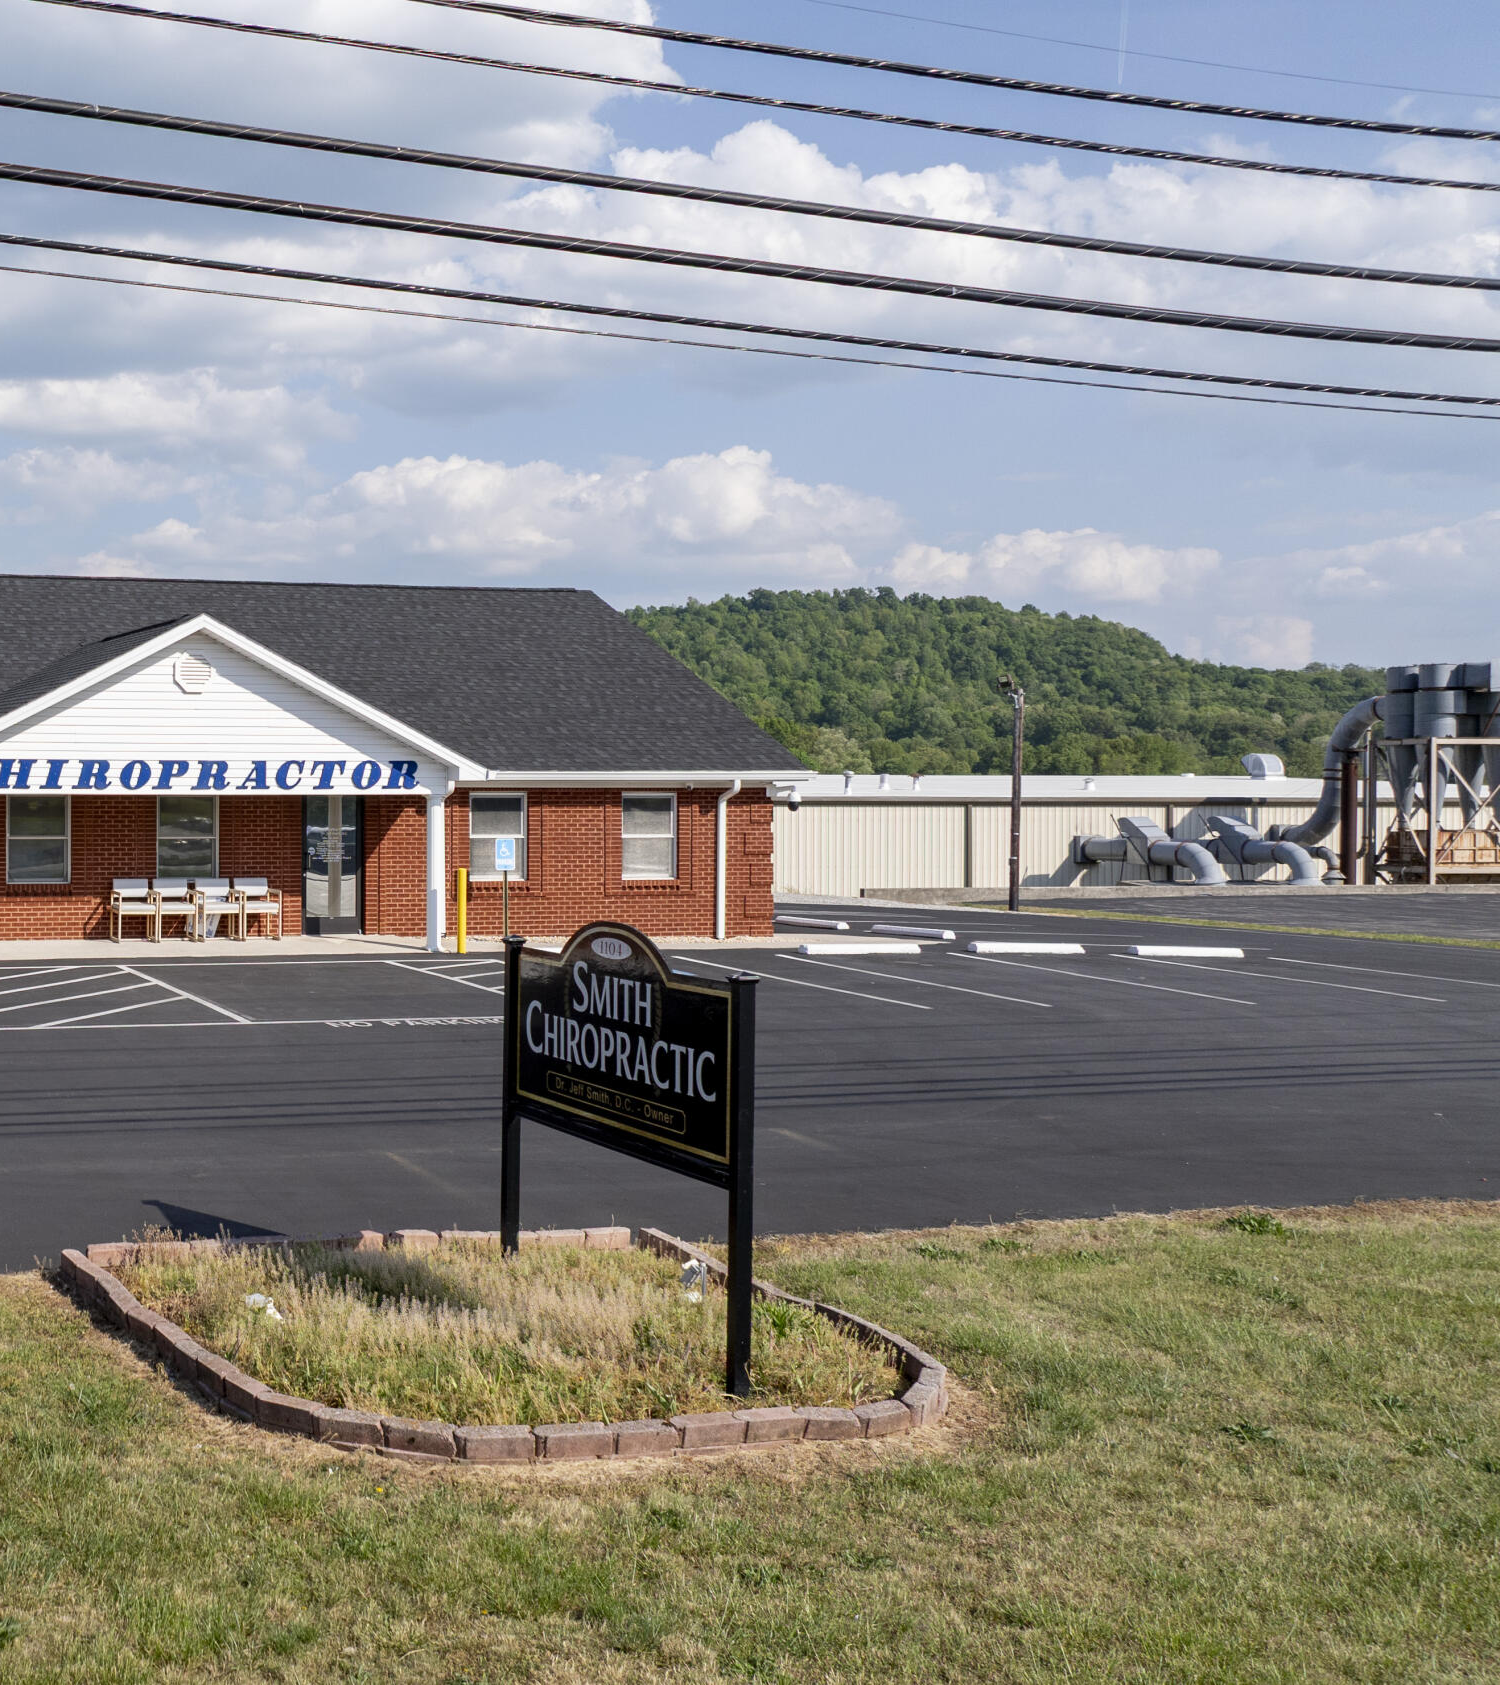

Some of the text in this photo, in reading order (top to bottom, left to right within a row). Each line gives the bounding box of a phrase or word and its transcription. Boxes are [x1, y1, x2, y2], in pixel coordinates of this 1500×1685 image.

[600, 940, 623, 957] 1104
[573, 961, 652, 1027] SMITH
[381, 1018, 505, 1027] PARKIN
[526, 1000, 717, 1102] CHIROPRACTIC
[555, 1077, 567, 1091] Dr.
[569, 1083, 584, 1097] Jeff
[643, 1104, 674, 1124] Owner
